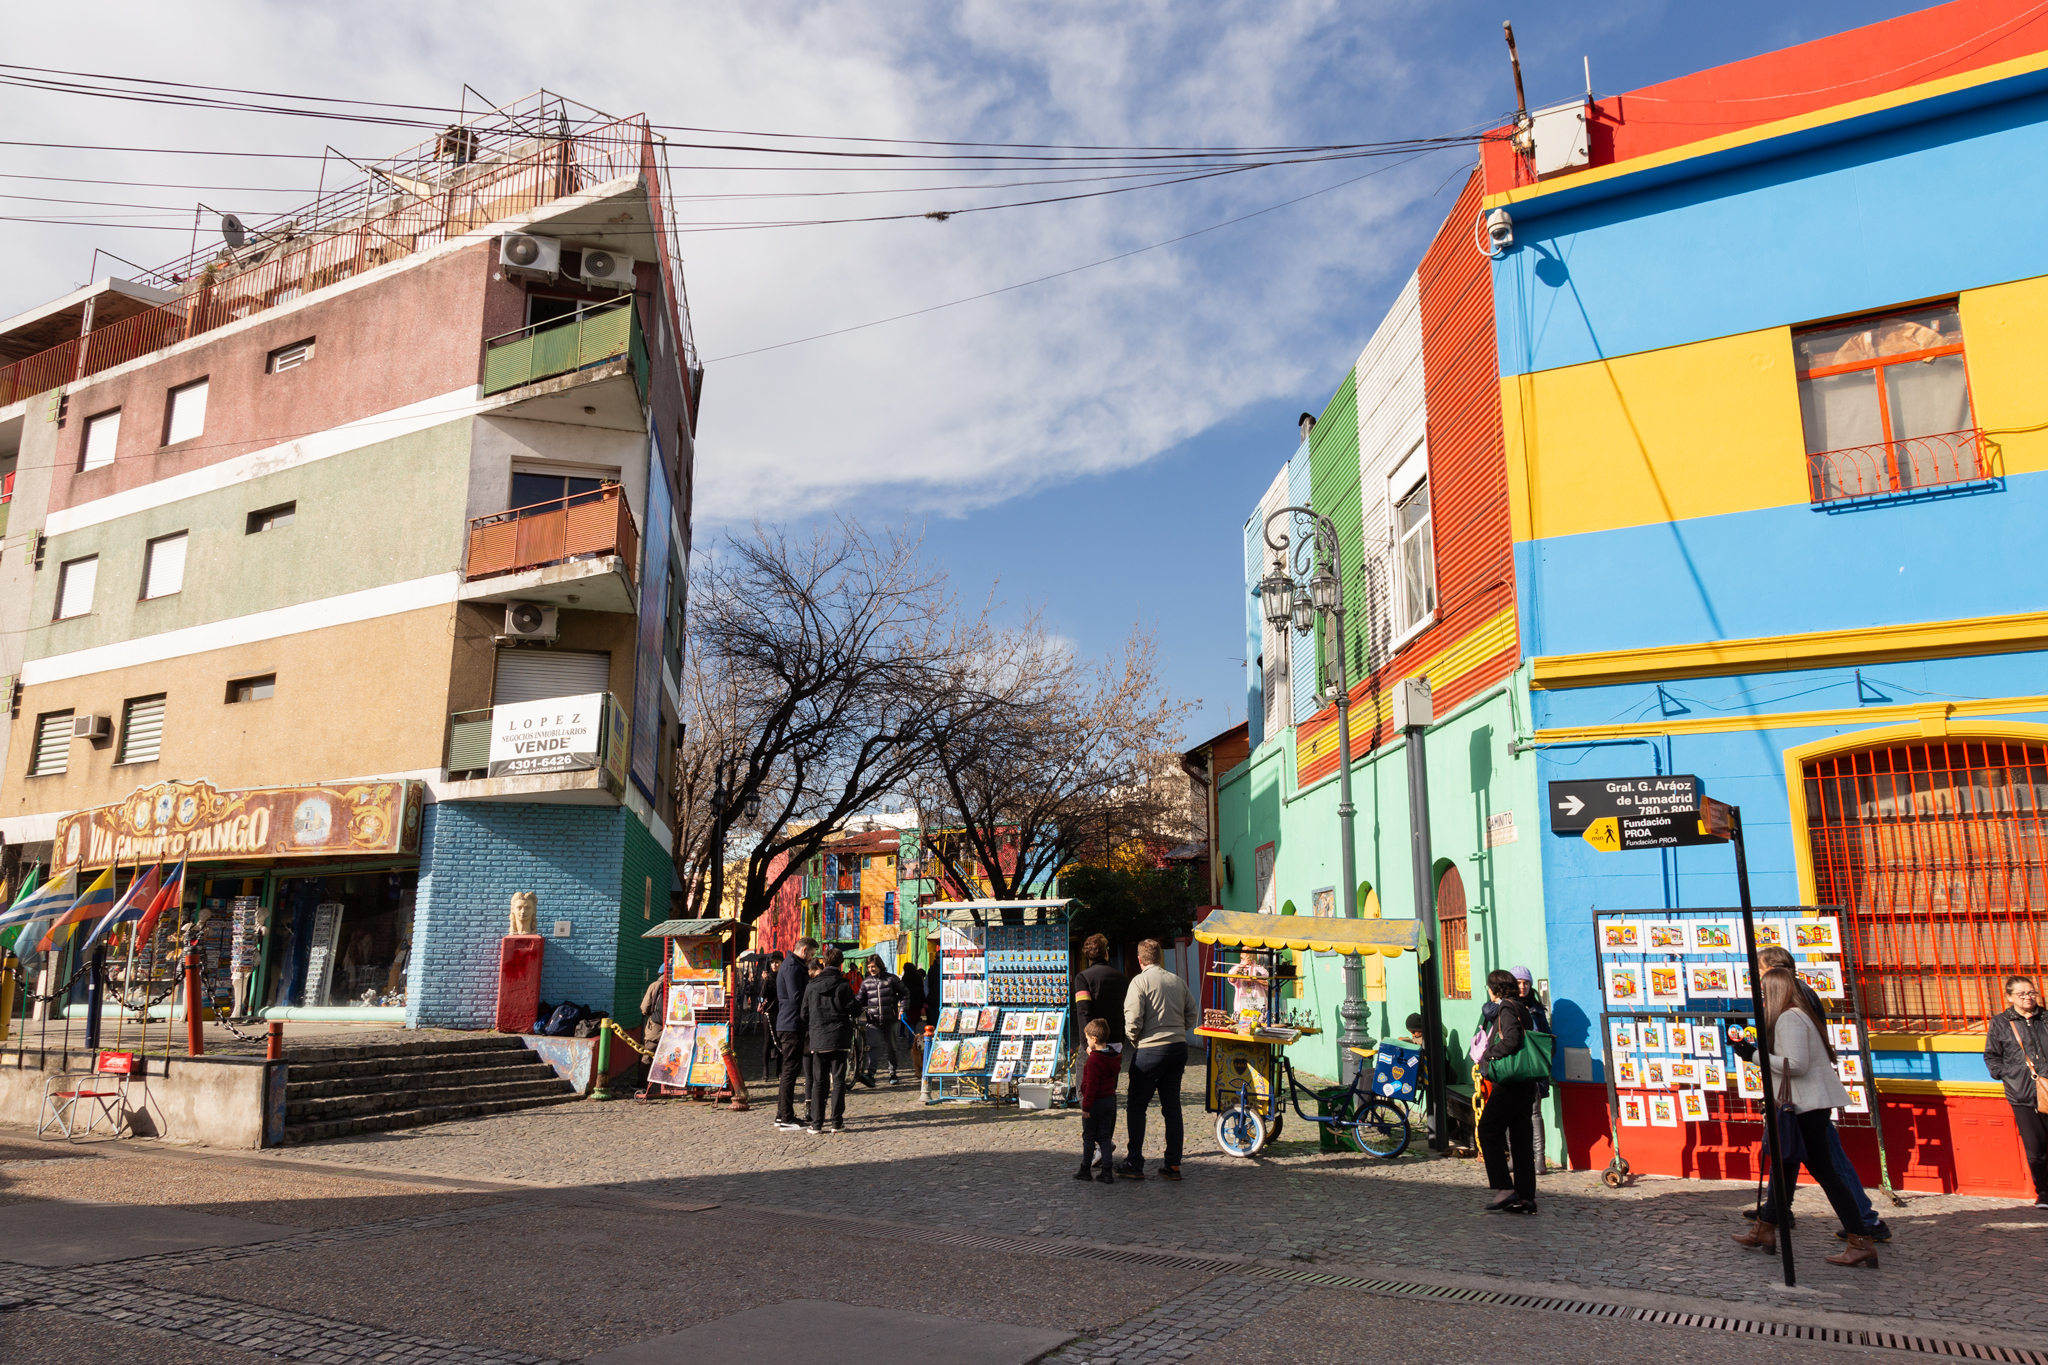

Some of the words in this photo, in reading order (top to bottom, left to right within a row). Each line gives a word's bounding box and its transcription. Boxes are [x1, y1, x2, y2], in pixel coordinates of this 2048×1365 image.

[509, 713, 581, 731] LOPEZ
[501, 732, 534, 743] NEGOCIOS
[534, 727, 587, 740] INMOBILIARIOS
[514, 737, 571, 754] VENDE
[508, 755, 572, 770] 4301-6426
[1606, 782, 1635, 793] Gral.
[1638, 781, 1651, 792] G.
[1655, 780, 1691, 791] Aráoz
[1616, 795, 1632, 806] de
[1634, 793, 1693, 805] Lamadrid
[1638, 805, 1660, 816] 780
[1670, 804, 1694, 813] 800
[1623, 817, 1671, 828] Fundación
[88, 823, 114, 864] VIA
[114, 832, 186, 860] CAMINITO
[186, 807, 271, 854] TANGO
[1624, 828, 1652, 838] PROA
[1626, 838, 1658, 846] Fundación
[1966, 1135, 2005, 1147] GAS
